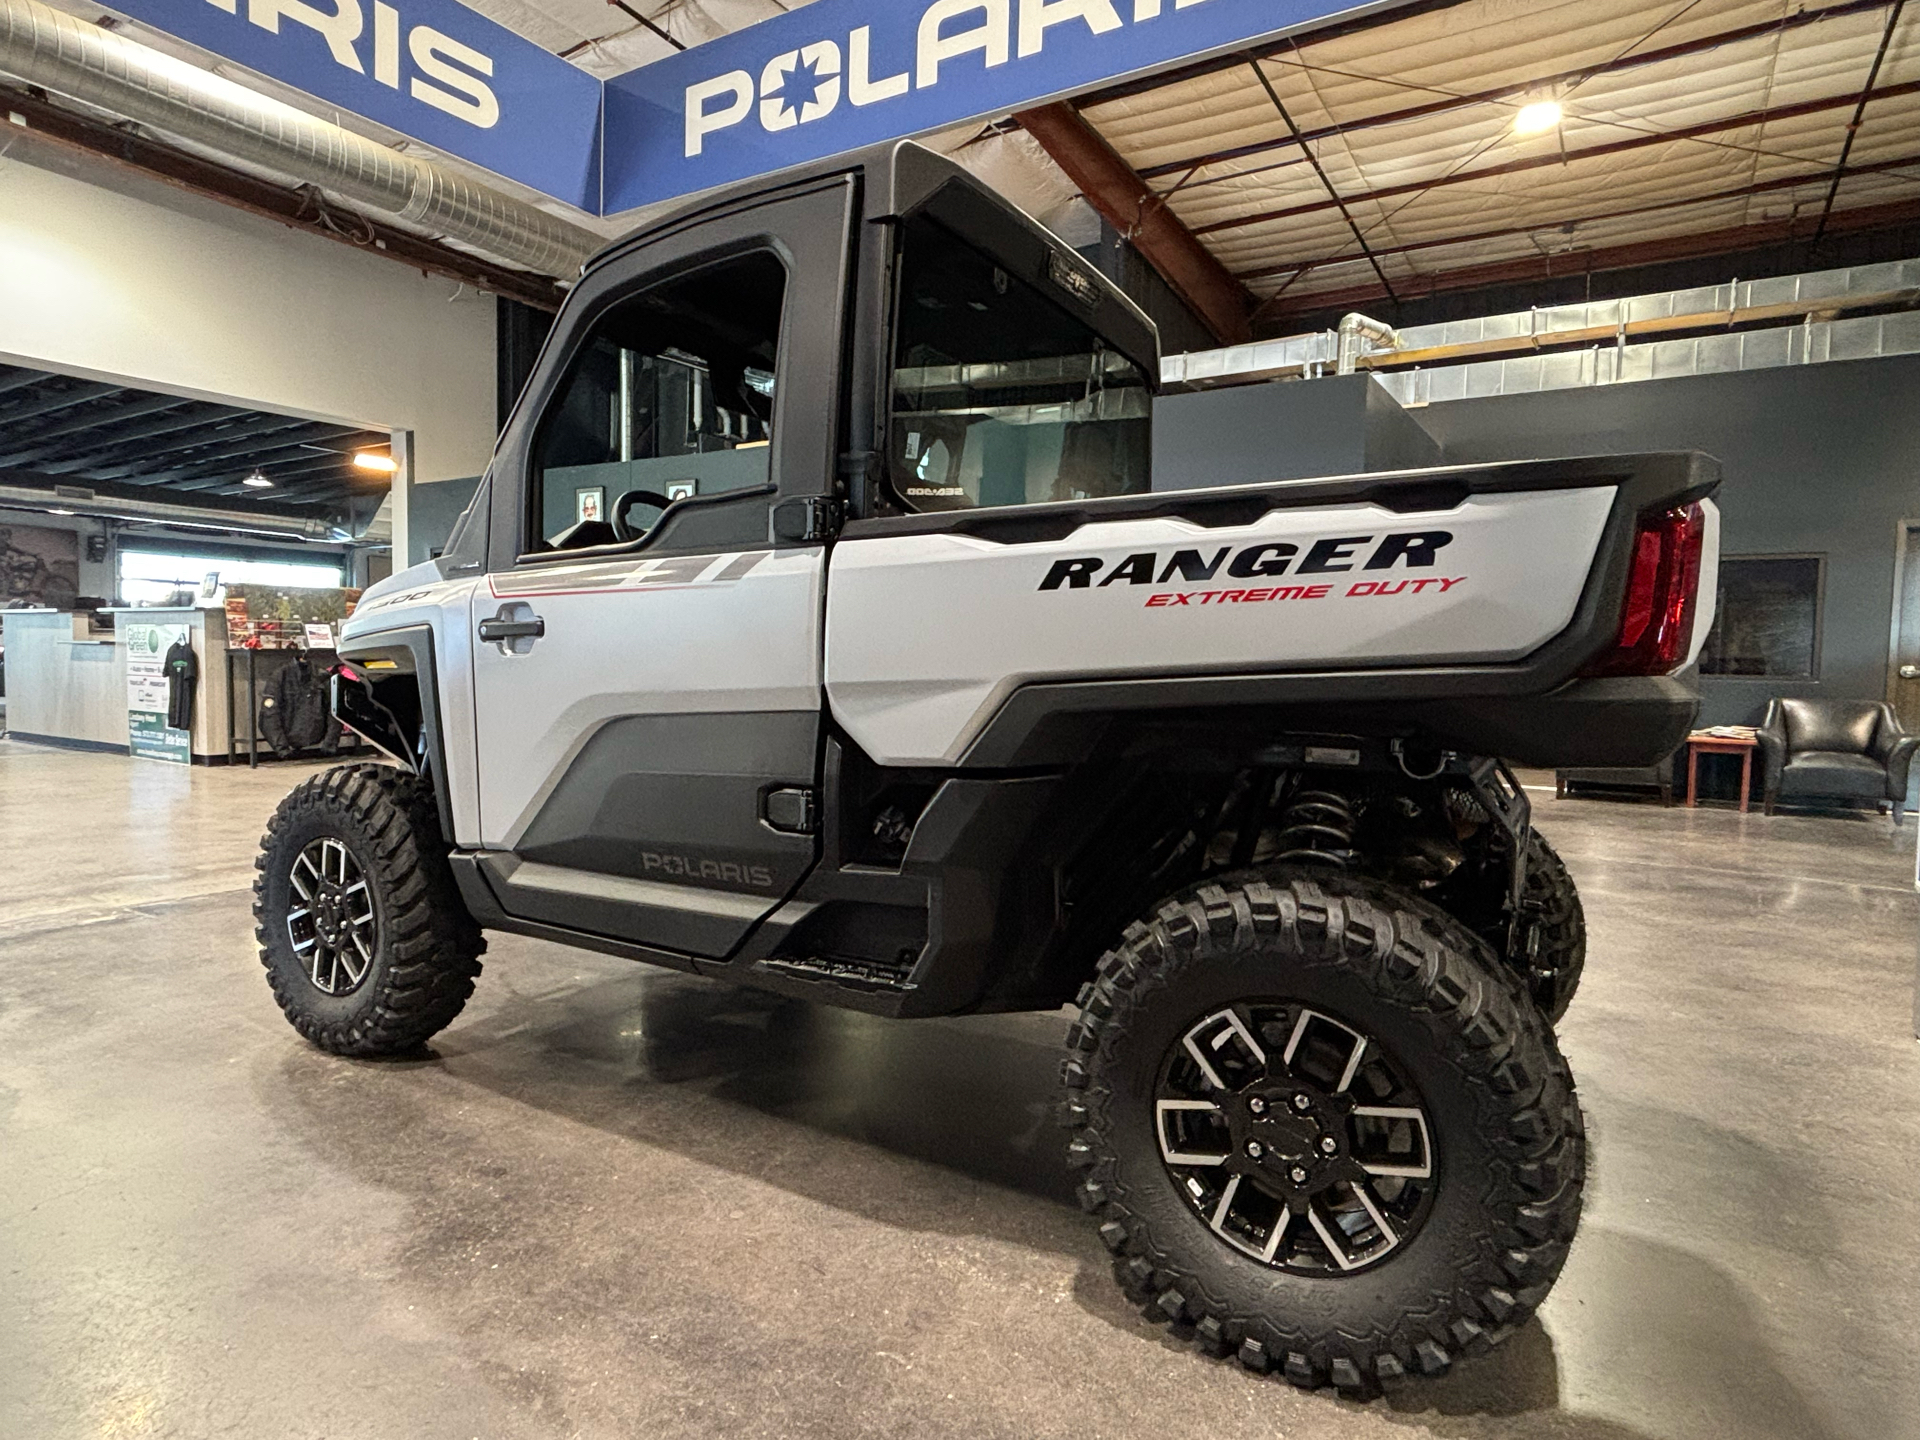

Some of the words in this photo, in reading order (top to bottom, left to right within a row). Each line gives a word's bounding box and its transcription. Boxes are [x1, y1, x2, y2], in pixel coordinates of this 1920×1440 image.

[206, 0, 499, 128] RIS
[1037, 530, 1454, 591] RANGER
[1144, 584, 1334, 608] EXTREME
[1345, 576, 1468, 598] DUTY
[641, 852, 773, 887] POLARIS
